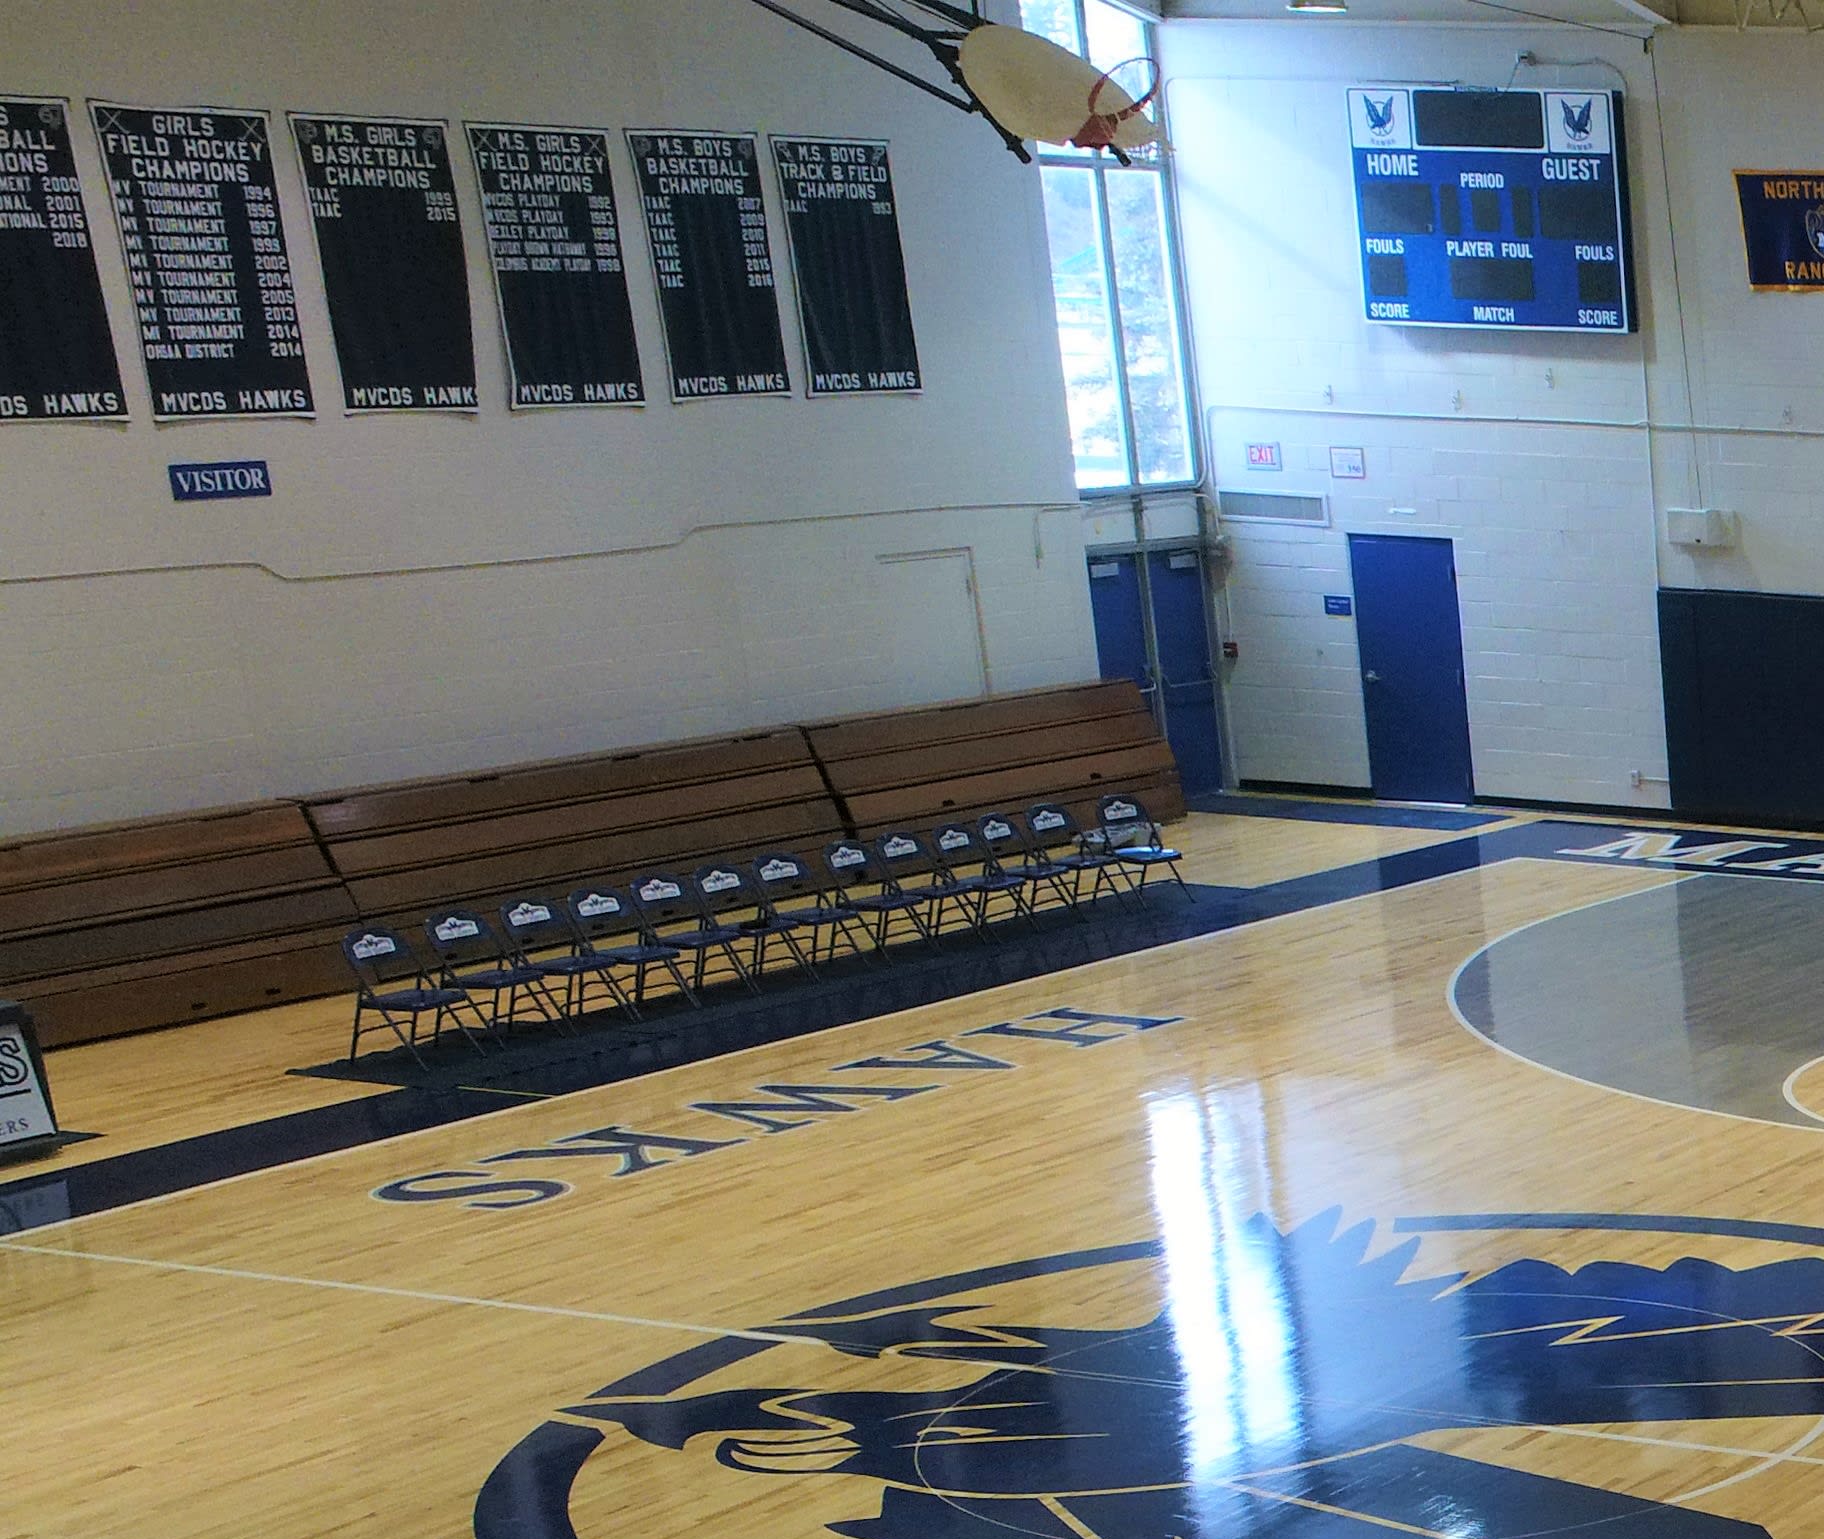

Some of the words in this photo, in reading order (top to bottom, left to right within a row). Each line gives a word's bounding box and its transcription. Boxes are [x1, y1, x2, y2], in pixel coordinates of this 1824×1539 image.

[152, 115, 215, 137] GIRLS
[324, 125, 359, 143] M.S.
[366, 126, 416, 146] GIRLS
[498, 132, 529, 150] M.S.
[535, 134, 581, 153] GIRLS
[106, 134, 169, 156] FIELD
[184, 138, 262, 161] HOCKEY
[311, 145, 436, 168] BASKETBALL
[657, 138, 688, 155] M.S.
[693, 140, 732, 157] BOYS
[798, 145, 825, 161] M.S.
[830, 146, 866, 163] BOYS
[132, 158, 249, 182] CHAMPIONS
[479, 152, 529, 171] FIELD
[540, 154, 604, 174] HOCKEY
[647, 158, 748, 176] BASKETBALL
[1366, 154, 1418, 176] HOME
[1542, 158, 1600, 181] GUEST
[325, 166, 430, 189] CHAMPIONS
[780, 163, 825, 180] TRACK
[848, 165, 887, 182] FIELD
[1460, 172, 1504, 188] PERIOD
[42, 177, 81, 192] 2000
[140, 181, 219, 199] TOURNAMENT
[500, 173, 593, 193] CHAMPIONS
[659, 177, 744, 195] CHAMPIONS
[798, 182, 876, 200] CHAMPIONS
[45, 196, 81, 211] 2001
[144, 200, 222, 216] TOURNAMENT
[312, 203, 342, 218] TAAC
[50, 213, 84, 229] 2015
[147, 217, 225, 233] TOURNAMENT
[150, 236, 229, 251] TOURNAMENT
[1366, 239, 1404, 254] FOULS
[1446, 241, 1494, 257] PLAYER
[1501, 243, 1533, 259] FOUL
[154, 254, 233, 269] TOURNAMENT
[1575, 245, 1614, 261] FOULS
[157, 271, 236, 287] TOURNAMENT
[161, 289, 238, 304] TOURNAMENT
[165, 307, 242, 322] TOURNAMENT
[264, 307, 295, 321] 2013
[1371, 303, 1410, 319] SCORE
[1473, 306, 1514, 322] MATCH
[1578, 309, 1618, 326] SCORE
[168, 325, 245, 340] TOURNAMENT
[267, 325, 299, 339] 2014
[678, 376, 727, 394] MVCDS
[737, 373, 784, 391] HAWKS
[816, 373, 860, 390] MVCDS
[868, 371, 916, 388] HAWKS
[161, 392, 226, 411] MVCDS
[239, 389, 305, 410] HAWKS
[353, 387, 412, 406] MVCDS
[520, 384, 573, 402] MVCDS
[584, 383, 638, 401] HAWKS
[44, 392, 119, 414] HAWKS
[1249, 445, 1276, 465] EXIT
[176, 467, 267, 494] VISITOR
[370, 1006, 1188, 1210] HAWKS
